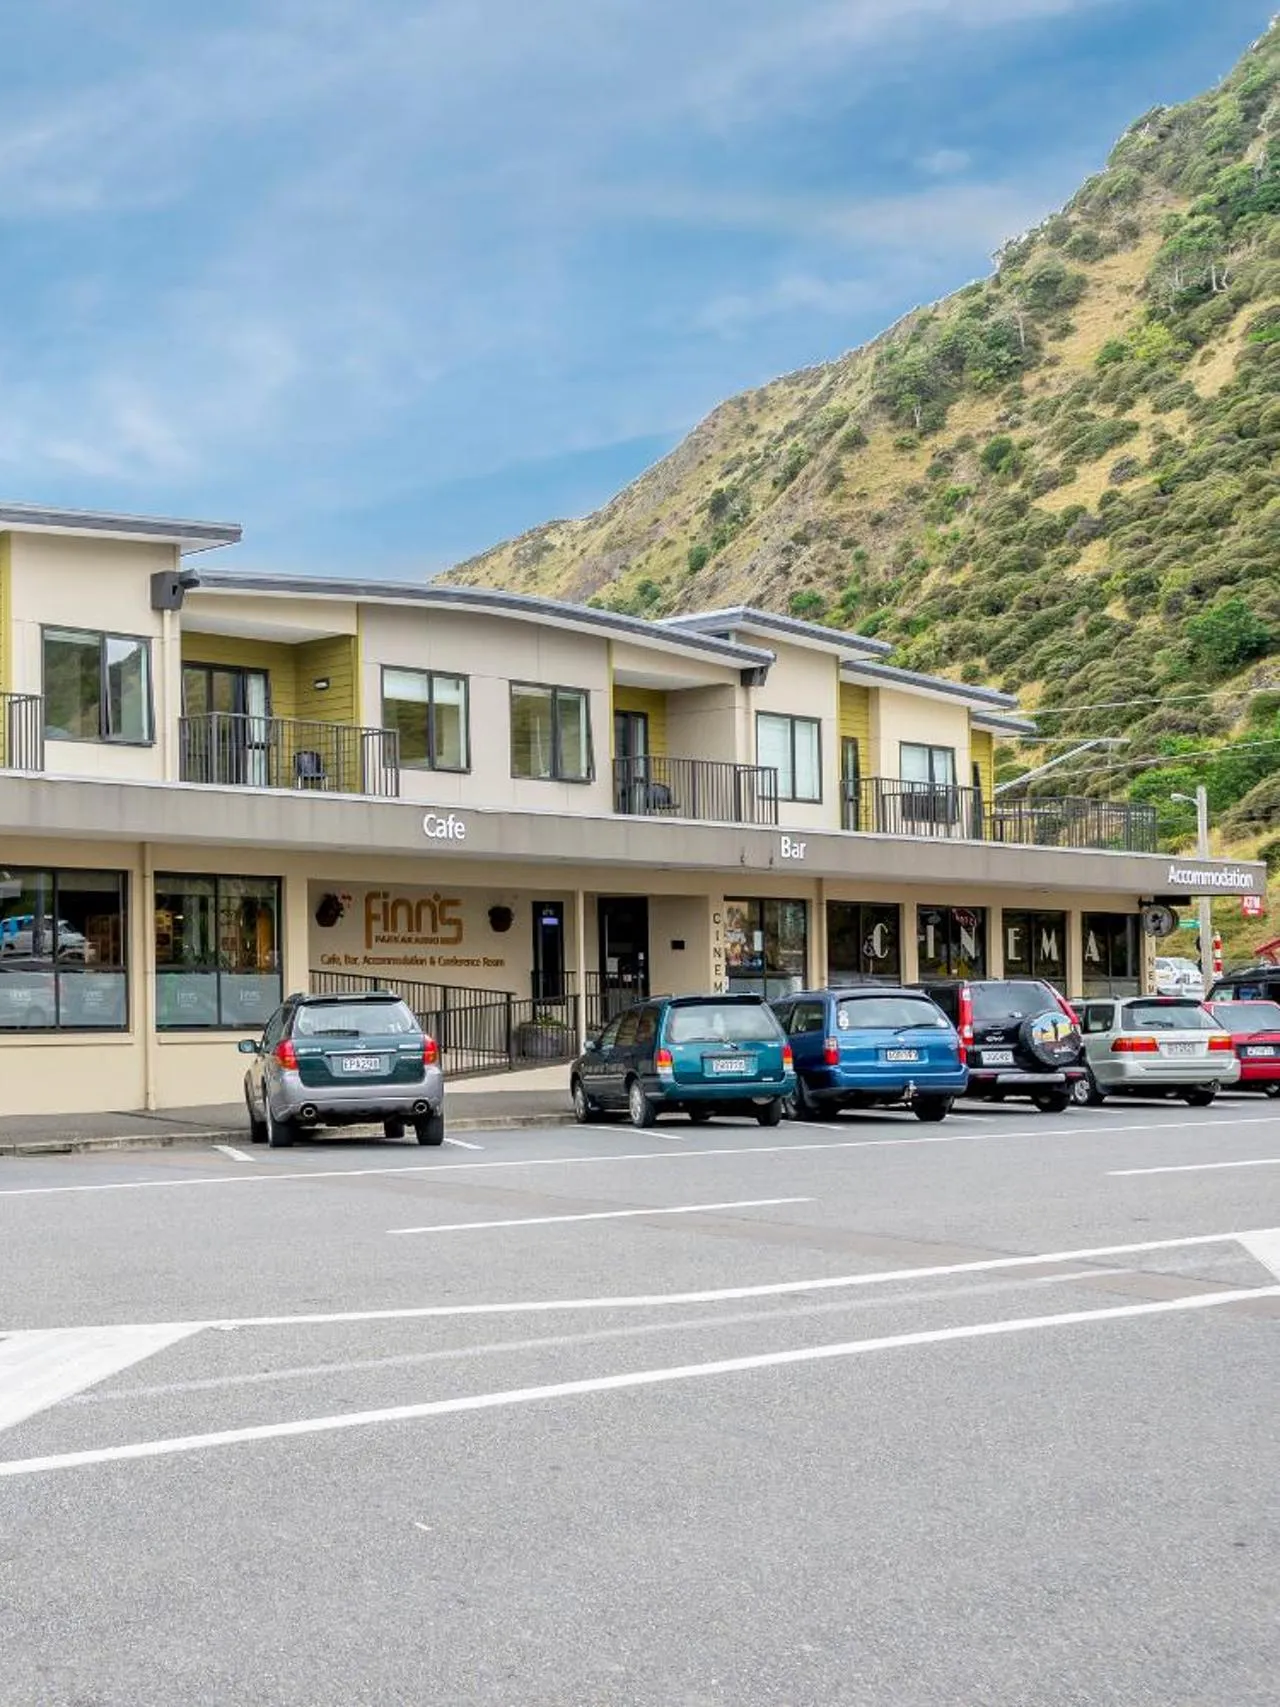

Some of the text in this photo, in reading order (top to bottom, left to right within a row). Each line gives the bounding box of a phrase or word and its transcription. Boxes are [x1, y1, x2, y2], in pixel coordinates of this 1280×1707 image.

[422, 812, 466, 840] Cafe
[780, 836, 807, 860] Bar
[1168, 864, 1254, 888] Accommodation
[712, 912, 724, 994] CINEM
